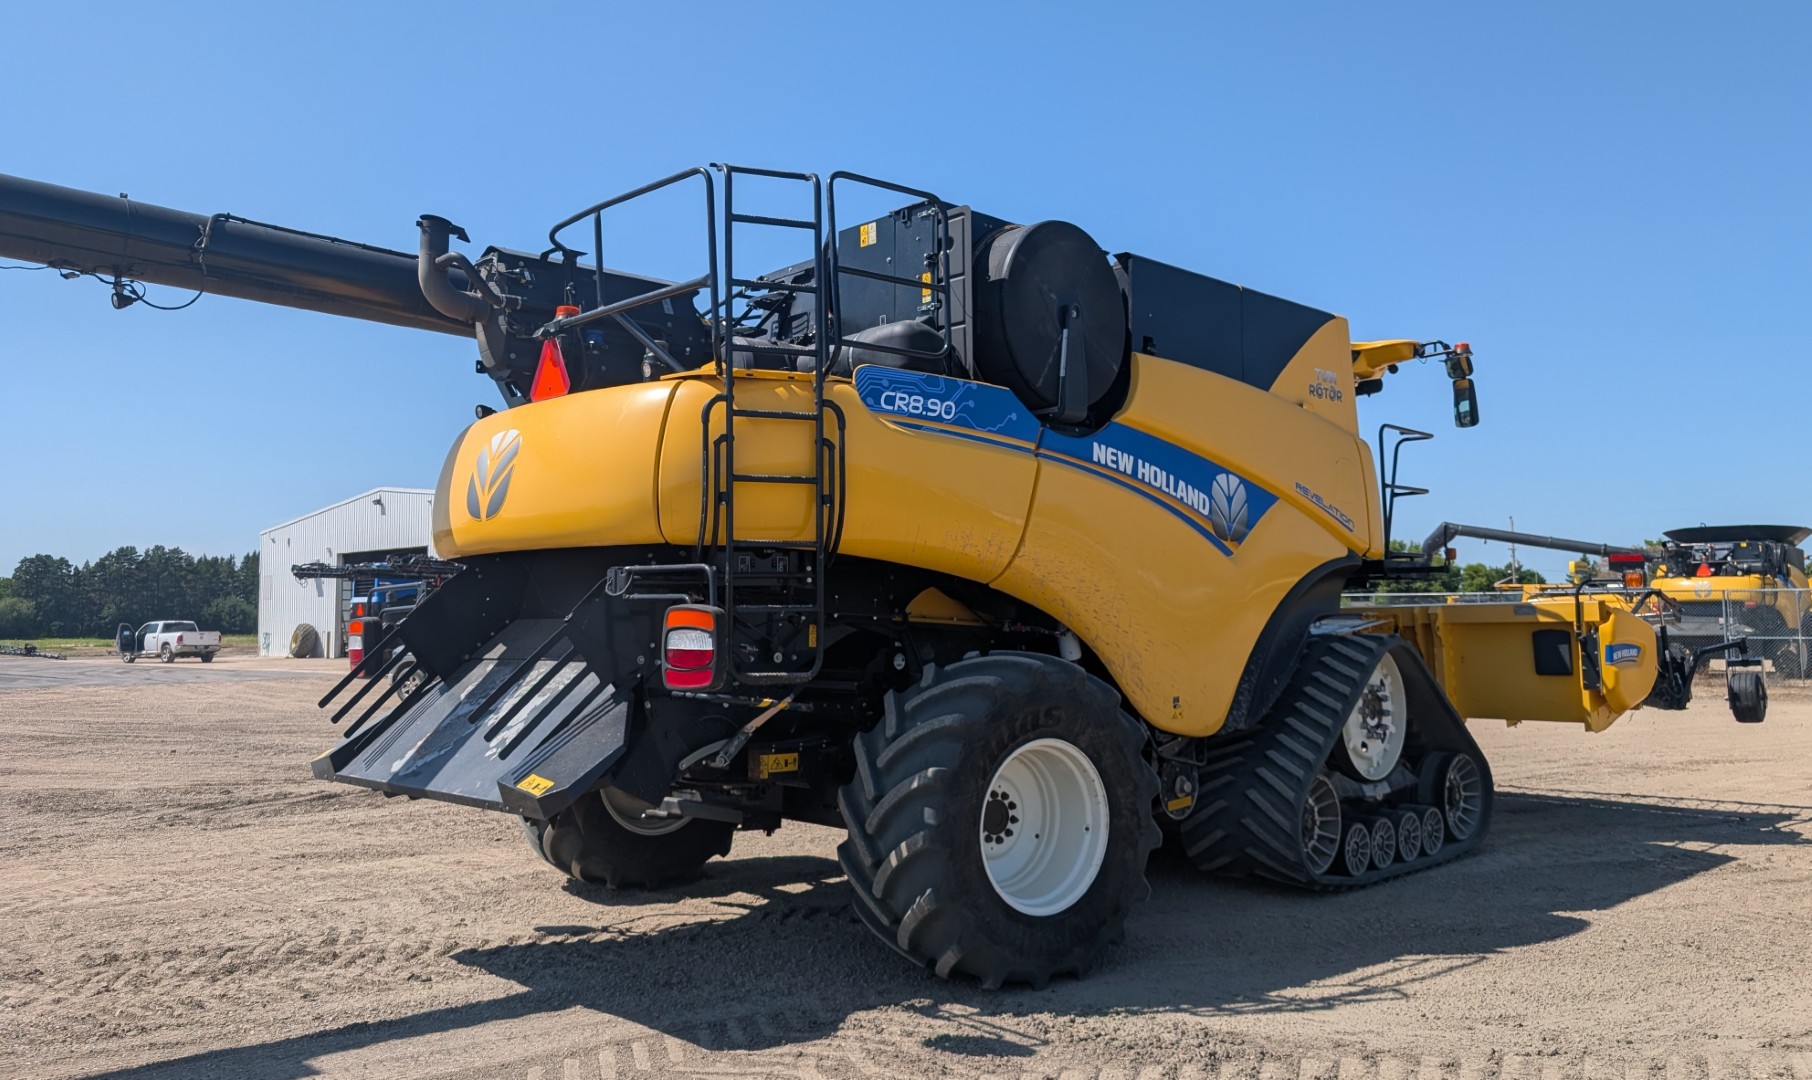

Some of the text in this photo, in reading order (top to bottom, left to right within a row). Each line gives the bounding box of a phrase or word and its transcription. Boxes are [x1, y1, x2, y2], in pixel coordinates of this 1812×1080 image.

[880, 391, 956, 420] CR8.90
[1308, 381, 1343, 403] ROTOR
[1092, 441, 1210, 516] NEW HOLLAND
